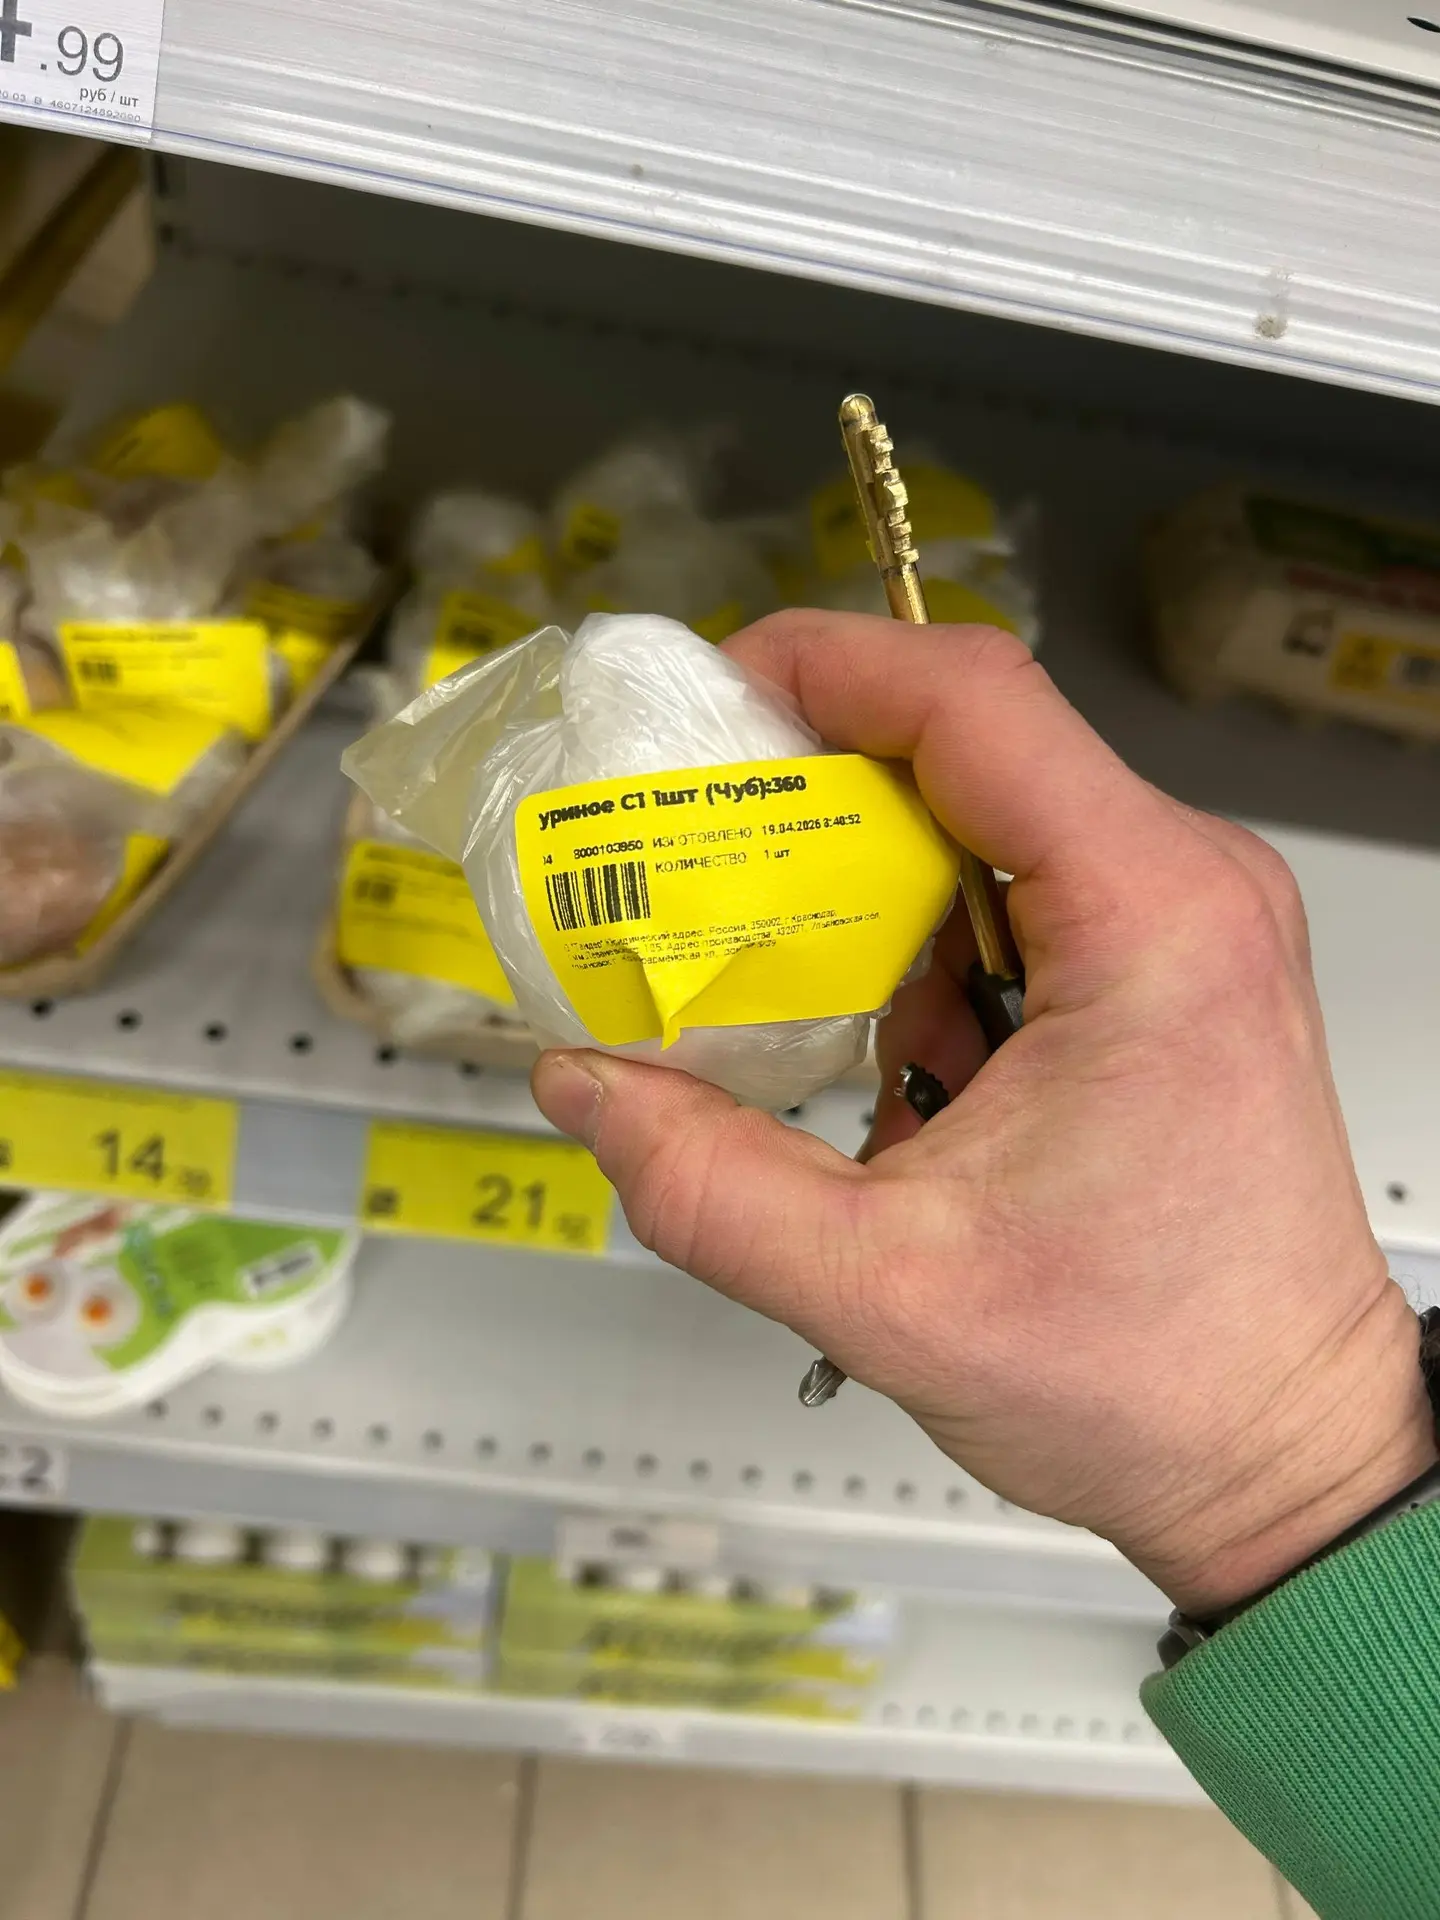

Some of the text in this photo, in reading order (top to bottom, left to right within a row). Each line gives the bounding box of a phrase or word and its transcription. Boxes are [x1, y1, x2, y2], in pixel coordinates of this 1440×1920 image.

[80, 87, 107, 103] руб
[120, 95, 139, 108] шт
[652, 788, 699, 807] 1шт
[653, 826, 752, 848] ИЗГОТОВЛЕНО
[762, 818, 822, 835] 19.04.2026
[655, 851, 747, 873] КОЛИЧЕСТВО
[774, 848, 790, 859] шт
[95, 1128, 165, 1185] 14
[472, 1172, 547, 1230] 21
